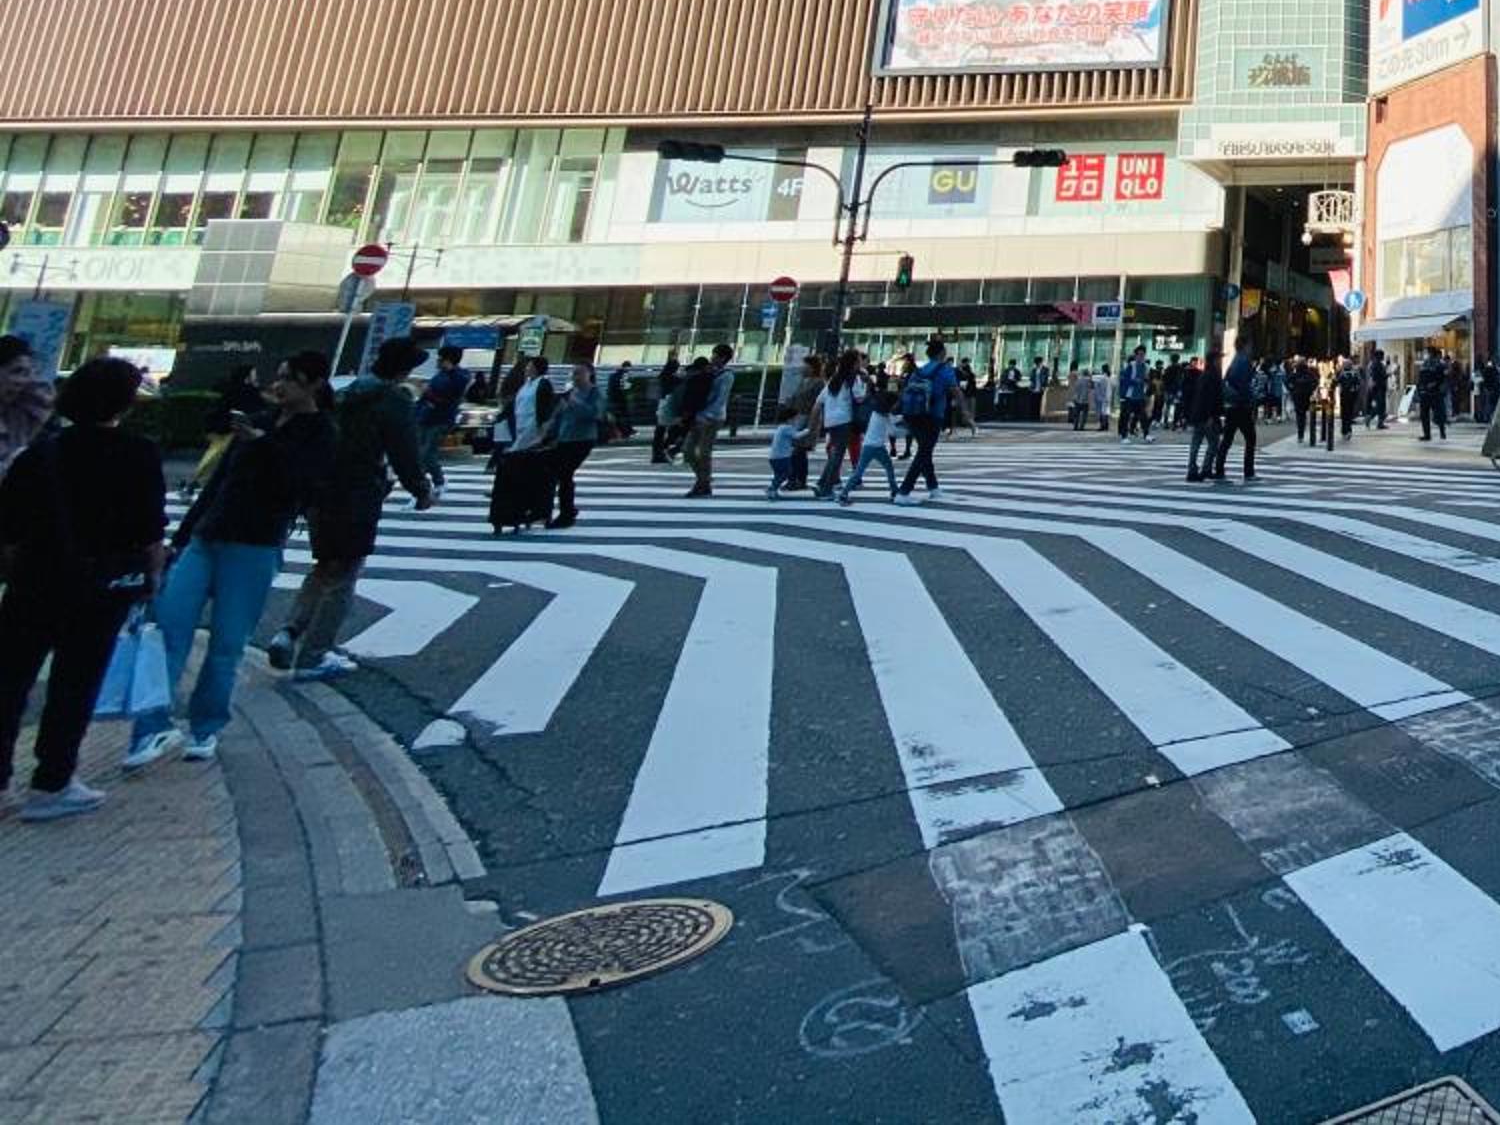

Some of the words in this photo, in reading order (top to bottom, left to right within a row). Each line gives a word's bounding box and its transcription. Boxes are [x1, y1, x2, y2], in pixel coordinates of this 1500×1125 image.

[1122, 157, 1156, 176] UNI
[668, 172, 752, 195] Watts
[932, 170, 976, 193] GU
[1120, 178, 1159, 196] QLO
